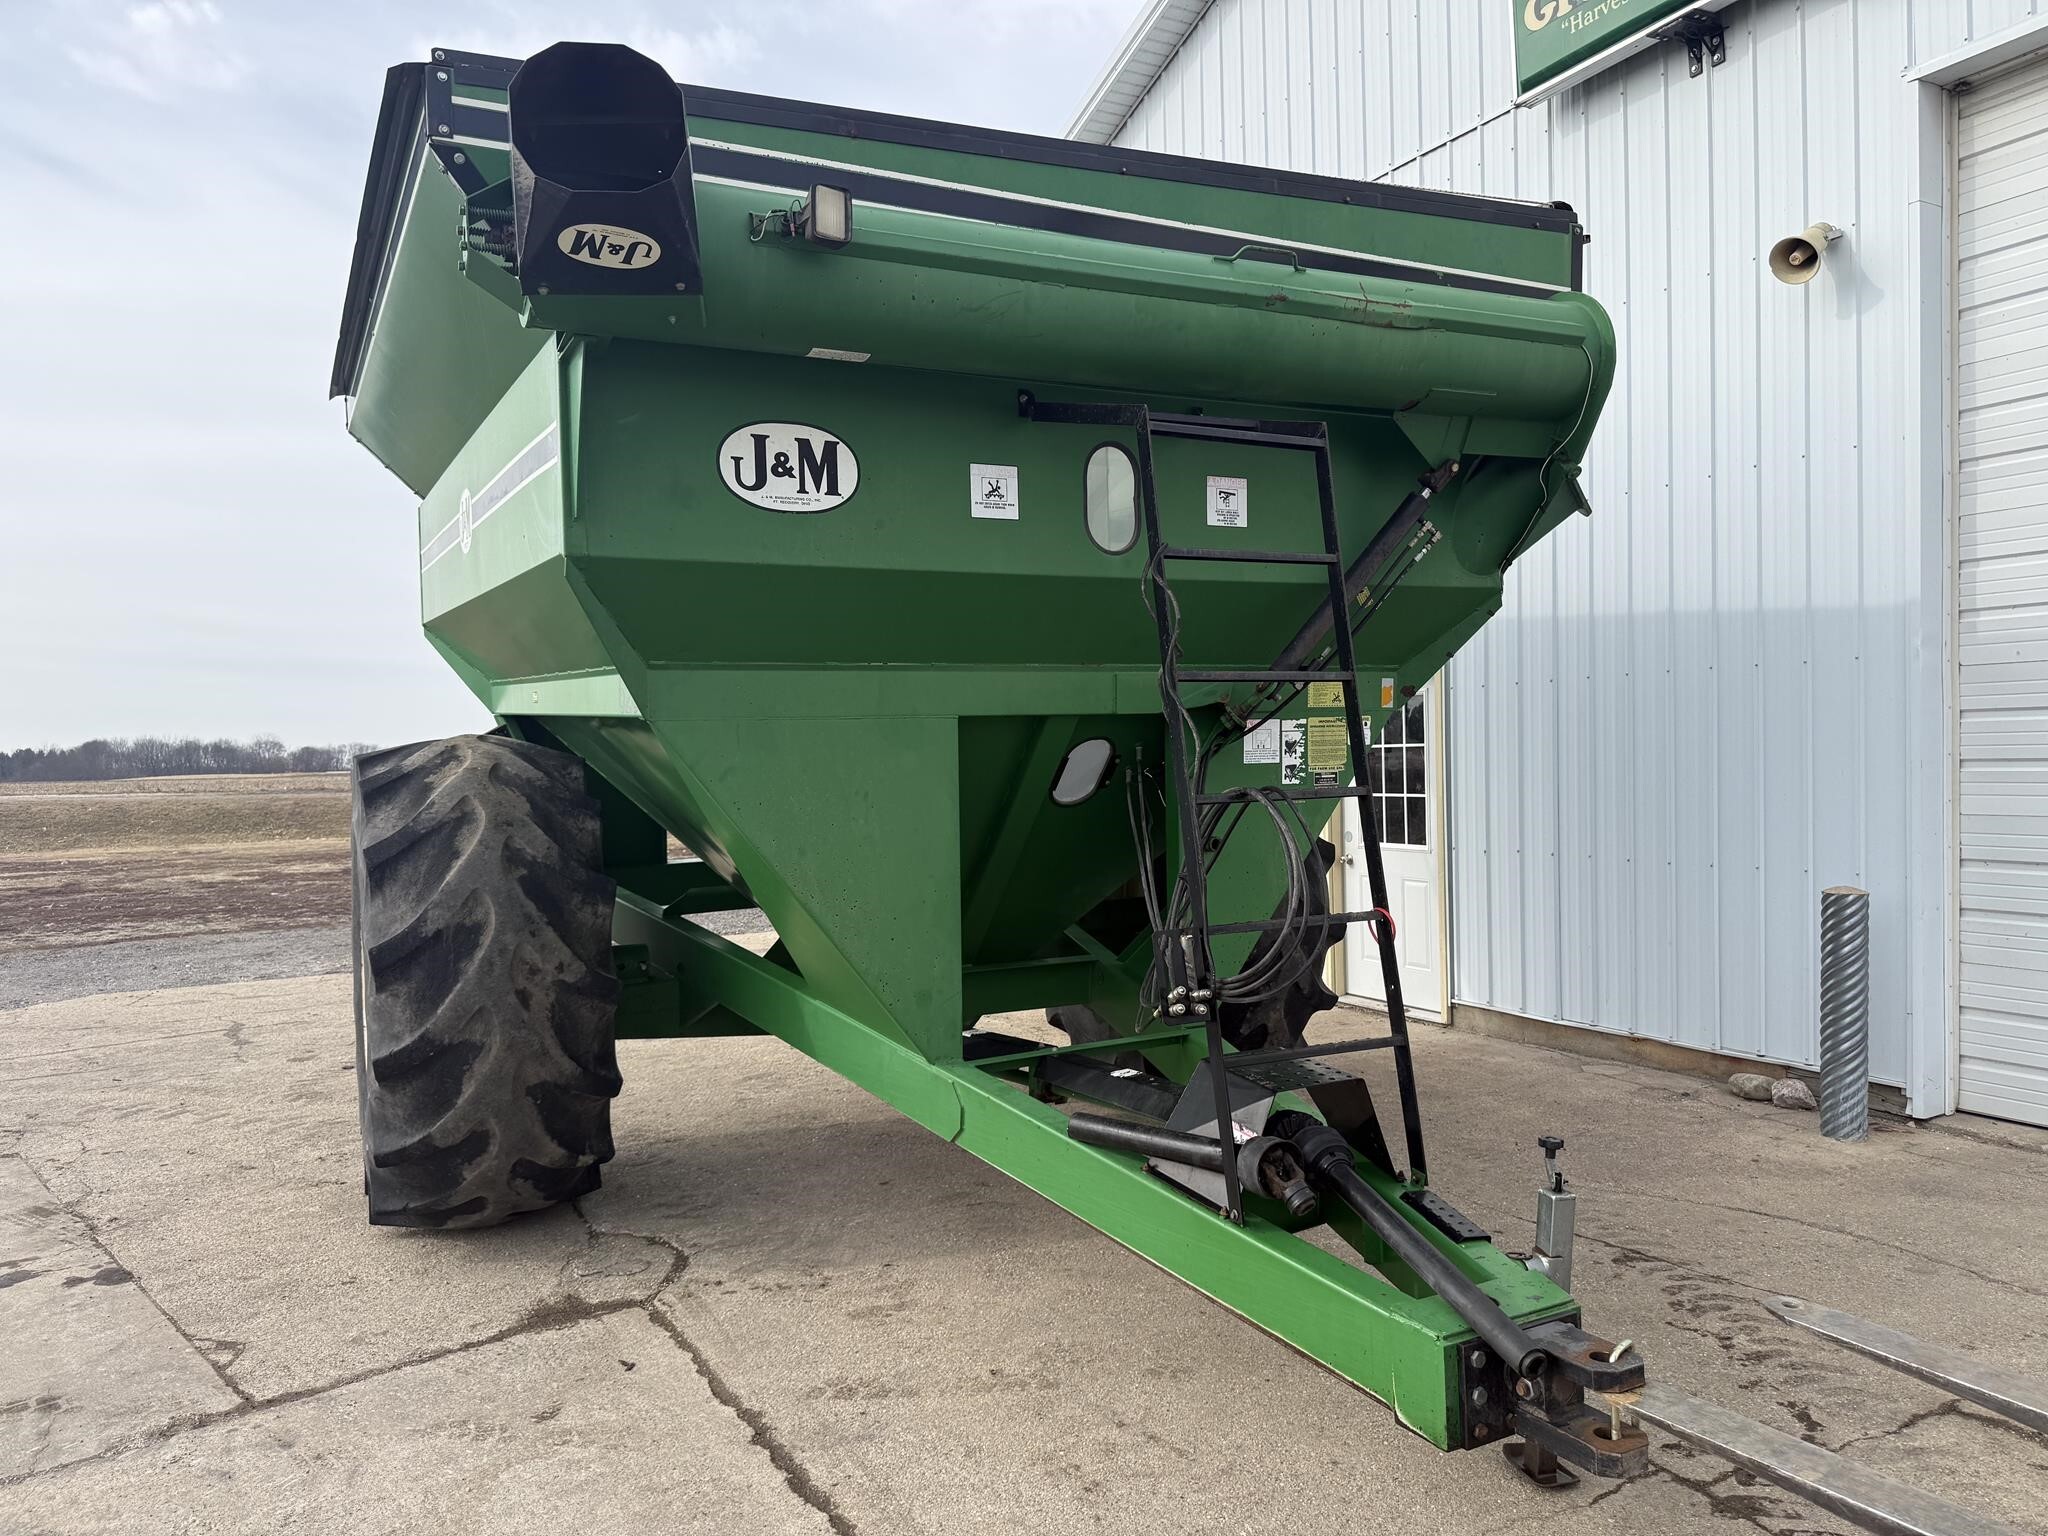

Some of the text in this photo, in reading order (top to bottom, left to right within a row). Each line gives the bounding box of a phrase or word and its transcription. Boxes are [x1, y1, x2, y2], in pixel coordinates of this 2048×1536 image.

[1561, 0, 1629, 34] “Harve
[567, 229, 652, 265] J&M
[730, 433, 842, 496] J&M
